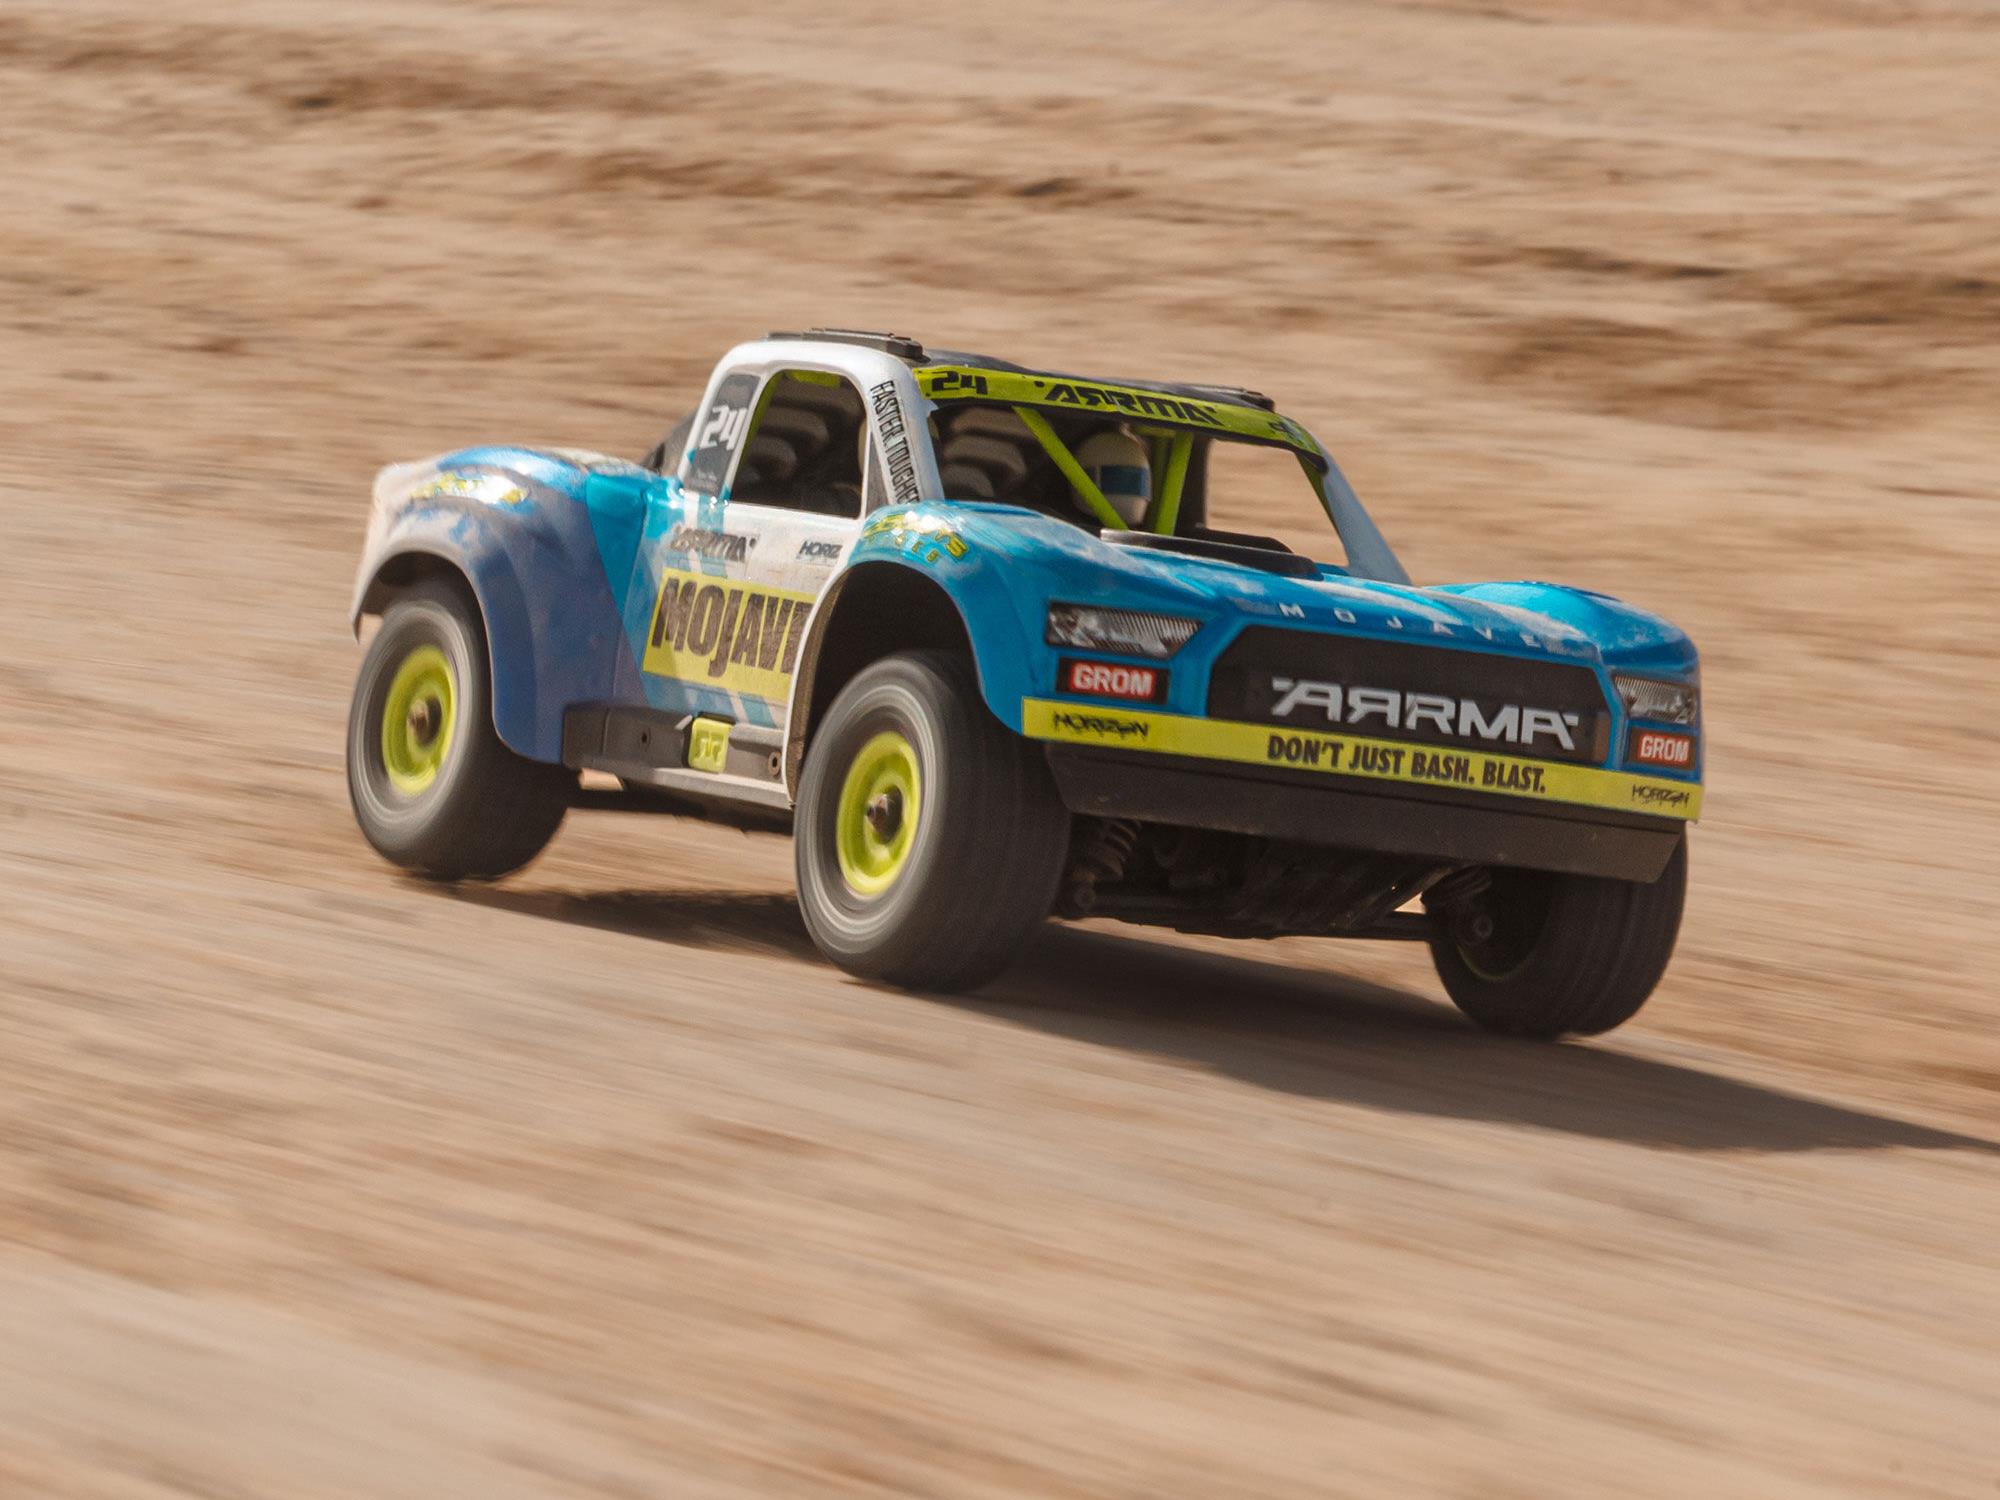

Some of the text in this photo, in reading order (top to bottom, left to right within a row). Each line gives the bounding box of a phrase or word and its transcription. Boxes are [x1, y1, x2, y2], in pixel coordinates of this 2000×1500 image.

[931, 371, 988, 395] 24
[700, 404, 748, 451] 24
[799, 540, 843, 559] HORIZ
[1072, 662, 1153, 697] GROM
[1267, 734, 1546, 794] DON'T JUST BASH. BLAST.
[1640, 735, 1690, 762] GROM
